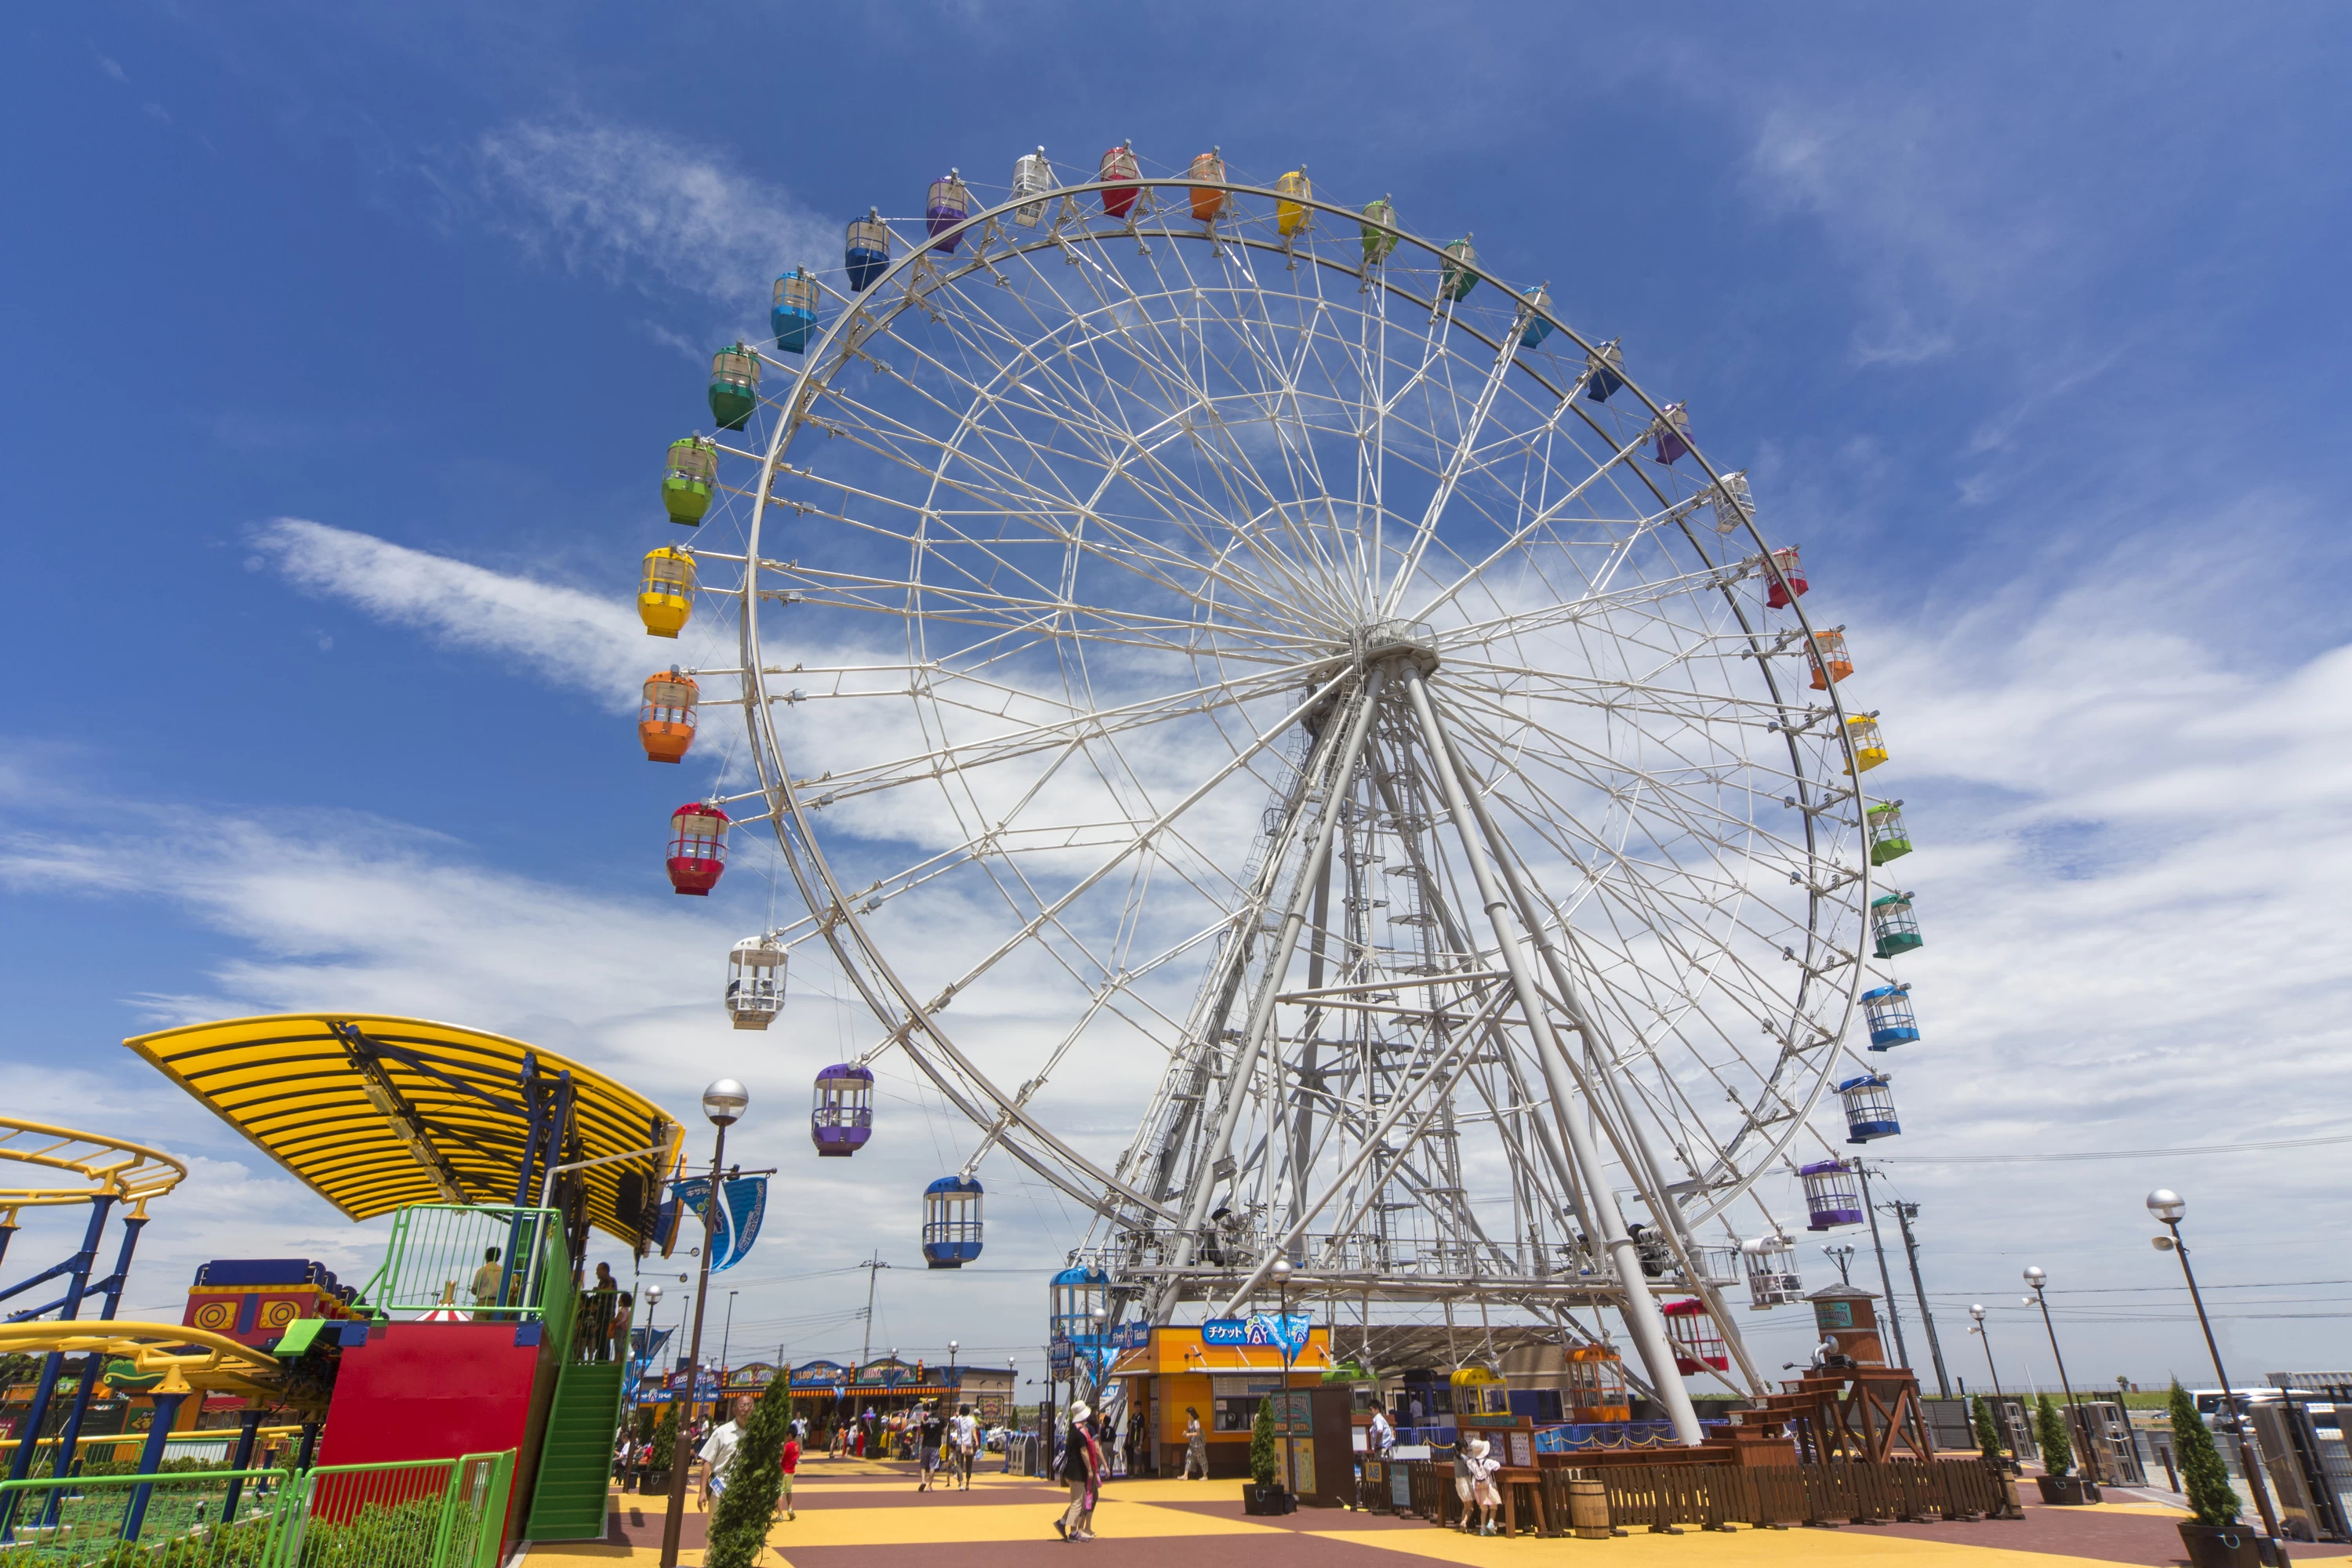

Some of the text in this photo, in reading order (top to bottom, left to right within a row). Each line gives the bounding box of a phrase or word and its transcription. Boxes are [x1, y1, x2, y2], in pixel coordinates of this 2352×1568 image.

[1112, 1332, 1124, 1343] チケット
[1134, 1329, 1147, 1340] Ticket
[1208, 1326, 1242, 1338] チケット
[799, 1370, 814, 1380] LOOP
[1105, 1428, 1111, 1439] 7
[1368, 1465, 1380, 1479] 入口
